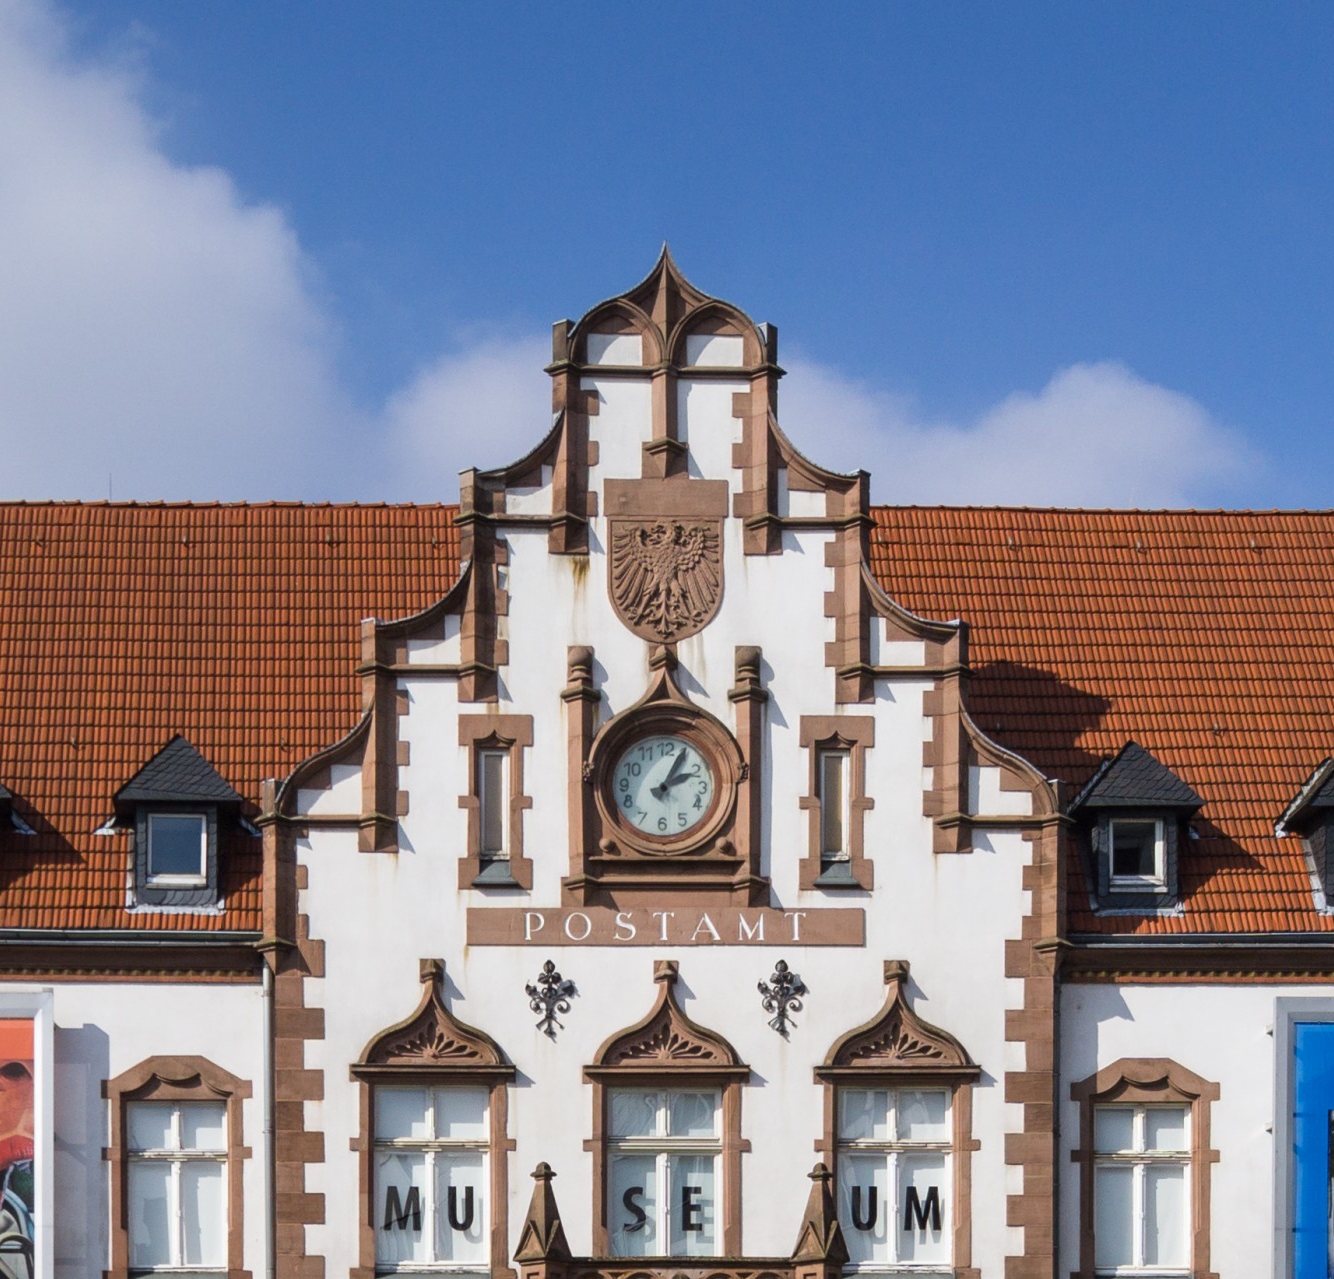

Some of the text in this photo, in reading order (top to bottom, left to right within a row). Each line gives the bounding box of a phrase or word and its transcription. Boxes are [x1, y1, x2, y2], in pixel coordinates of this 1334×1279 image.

[638, 746, 654, 761] 11
[657, 742, 675, 757] 12
[624, 762, 641, 777] 10
[619, 778, 629, 792] 9
[698, 781, 708, 795] 3
[623, 795, 633, 809] 8
[692, 794, 703, 811] 4
[638, 811, 648, 825] 7
[657, 817, 667, 832] 6
[678, 812, 688, 827] 5
[523, 911, 807, 941] POSTAMT
